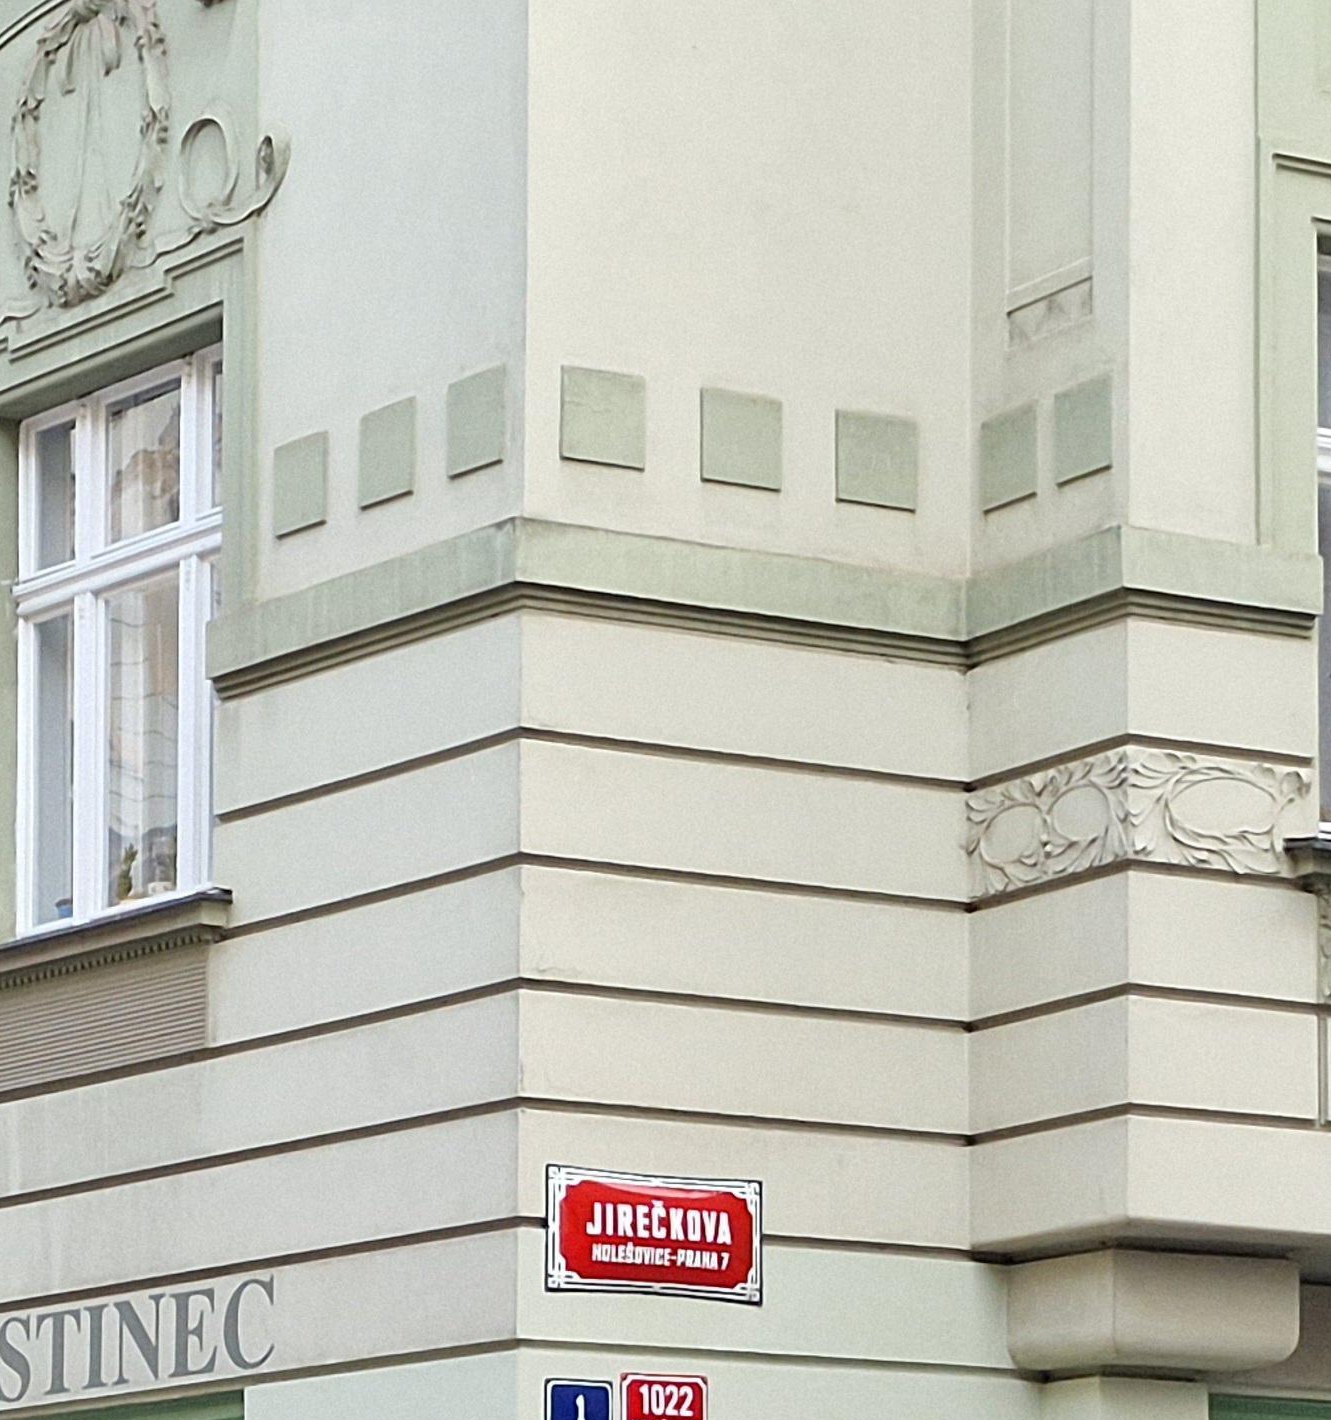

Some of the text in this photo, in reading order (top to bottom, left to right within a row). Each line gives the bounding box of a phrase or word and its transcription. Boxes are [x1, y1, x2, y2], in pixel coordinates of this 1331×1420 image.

[585, 1199, 733, 1246] JIREČKOVA
[591, 1241, 730, 1271] HOLEŠOVICE-PRAHA 7
[638, 1383, 694, 1417] 1022
